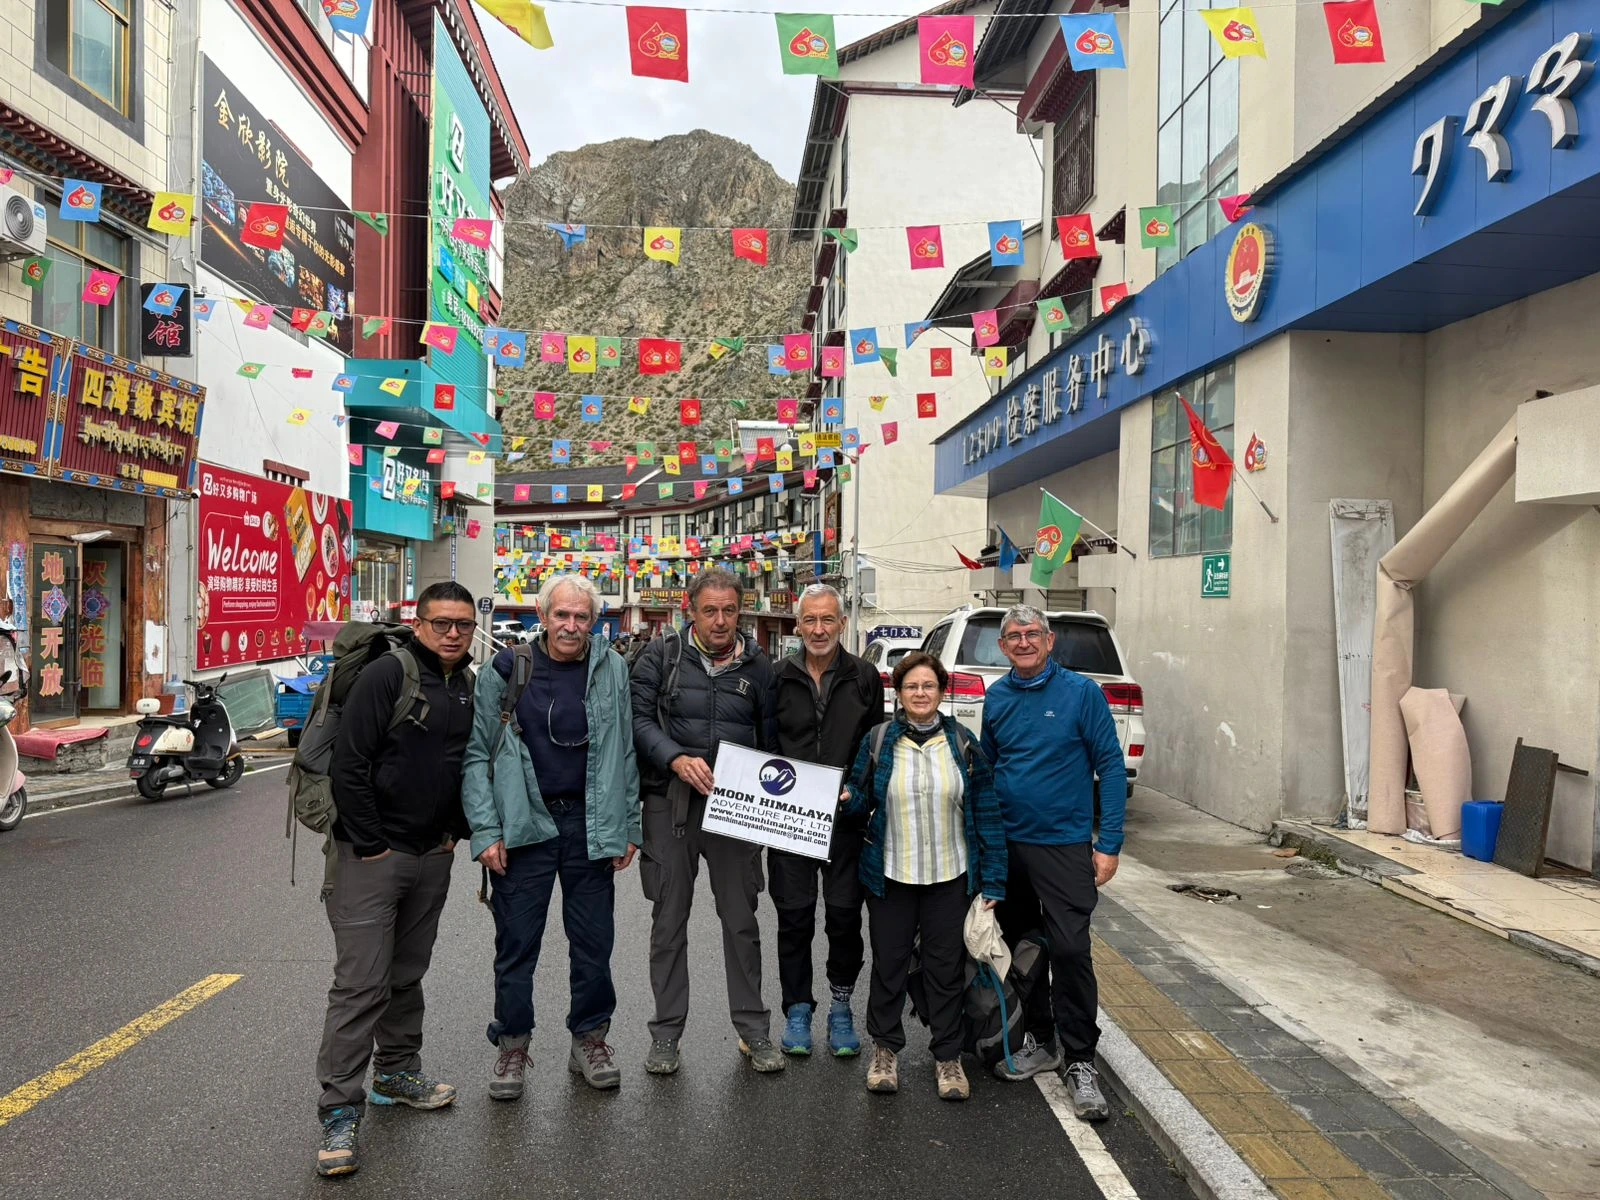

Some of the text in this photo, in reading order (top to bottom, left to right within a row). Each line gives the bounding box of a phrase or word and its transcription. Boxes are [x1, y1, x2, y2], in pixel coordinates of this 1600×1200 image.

[214, 89, 289, 188] 金欣影院
[963, 317, 1151, 465] 12309 检察服务中心
[208, 527, 278, 575] Welcome
[39, 551, 65, 697] 地开放
[80, 559, 109, 688] 欢光临
[710, 806, 827, 840] www.moonhimalaya.com
[711, 798, 780, 820] ADVENTURE
[784, 816, 807, 828] PVT.
[713, 787, 833, 823] MOON HIMALAYA
[708, 814, 828, 847] moonhimalayaadventure@gmail.com
